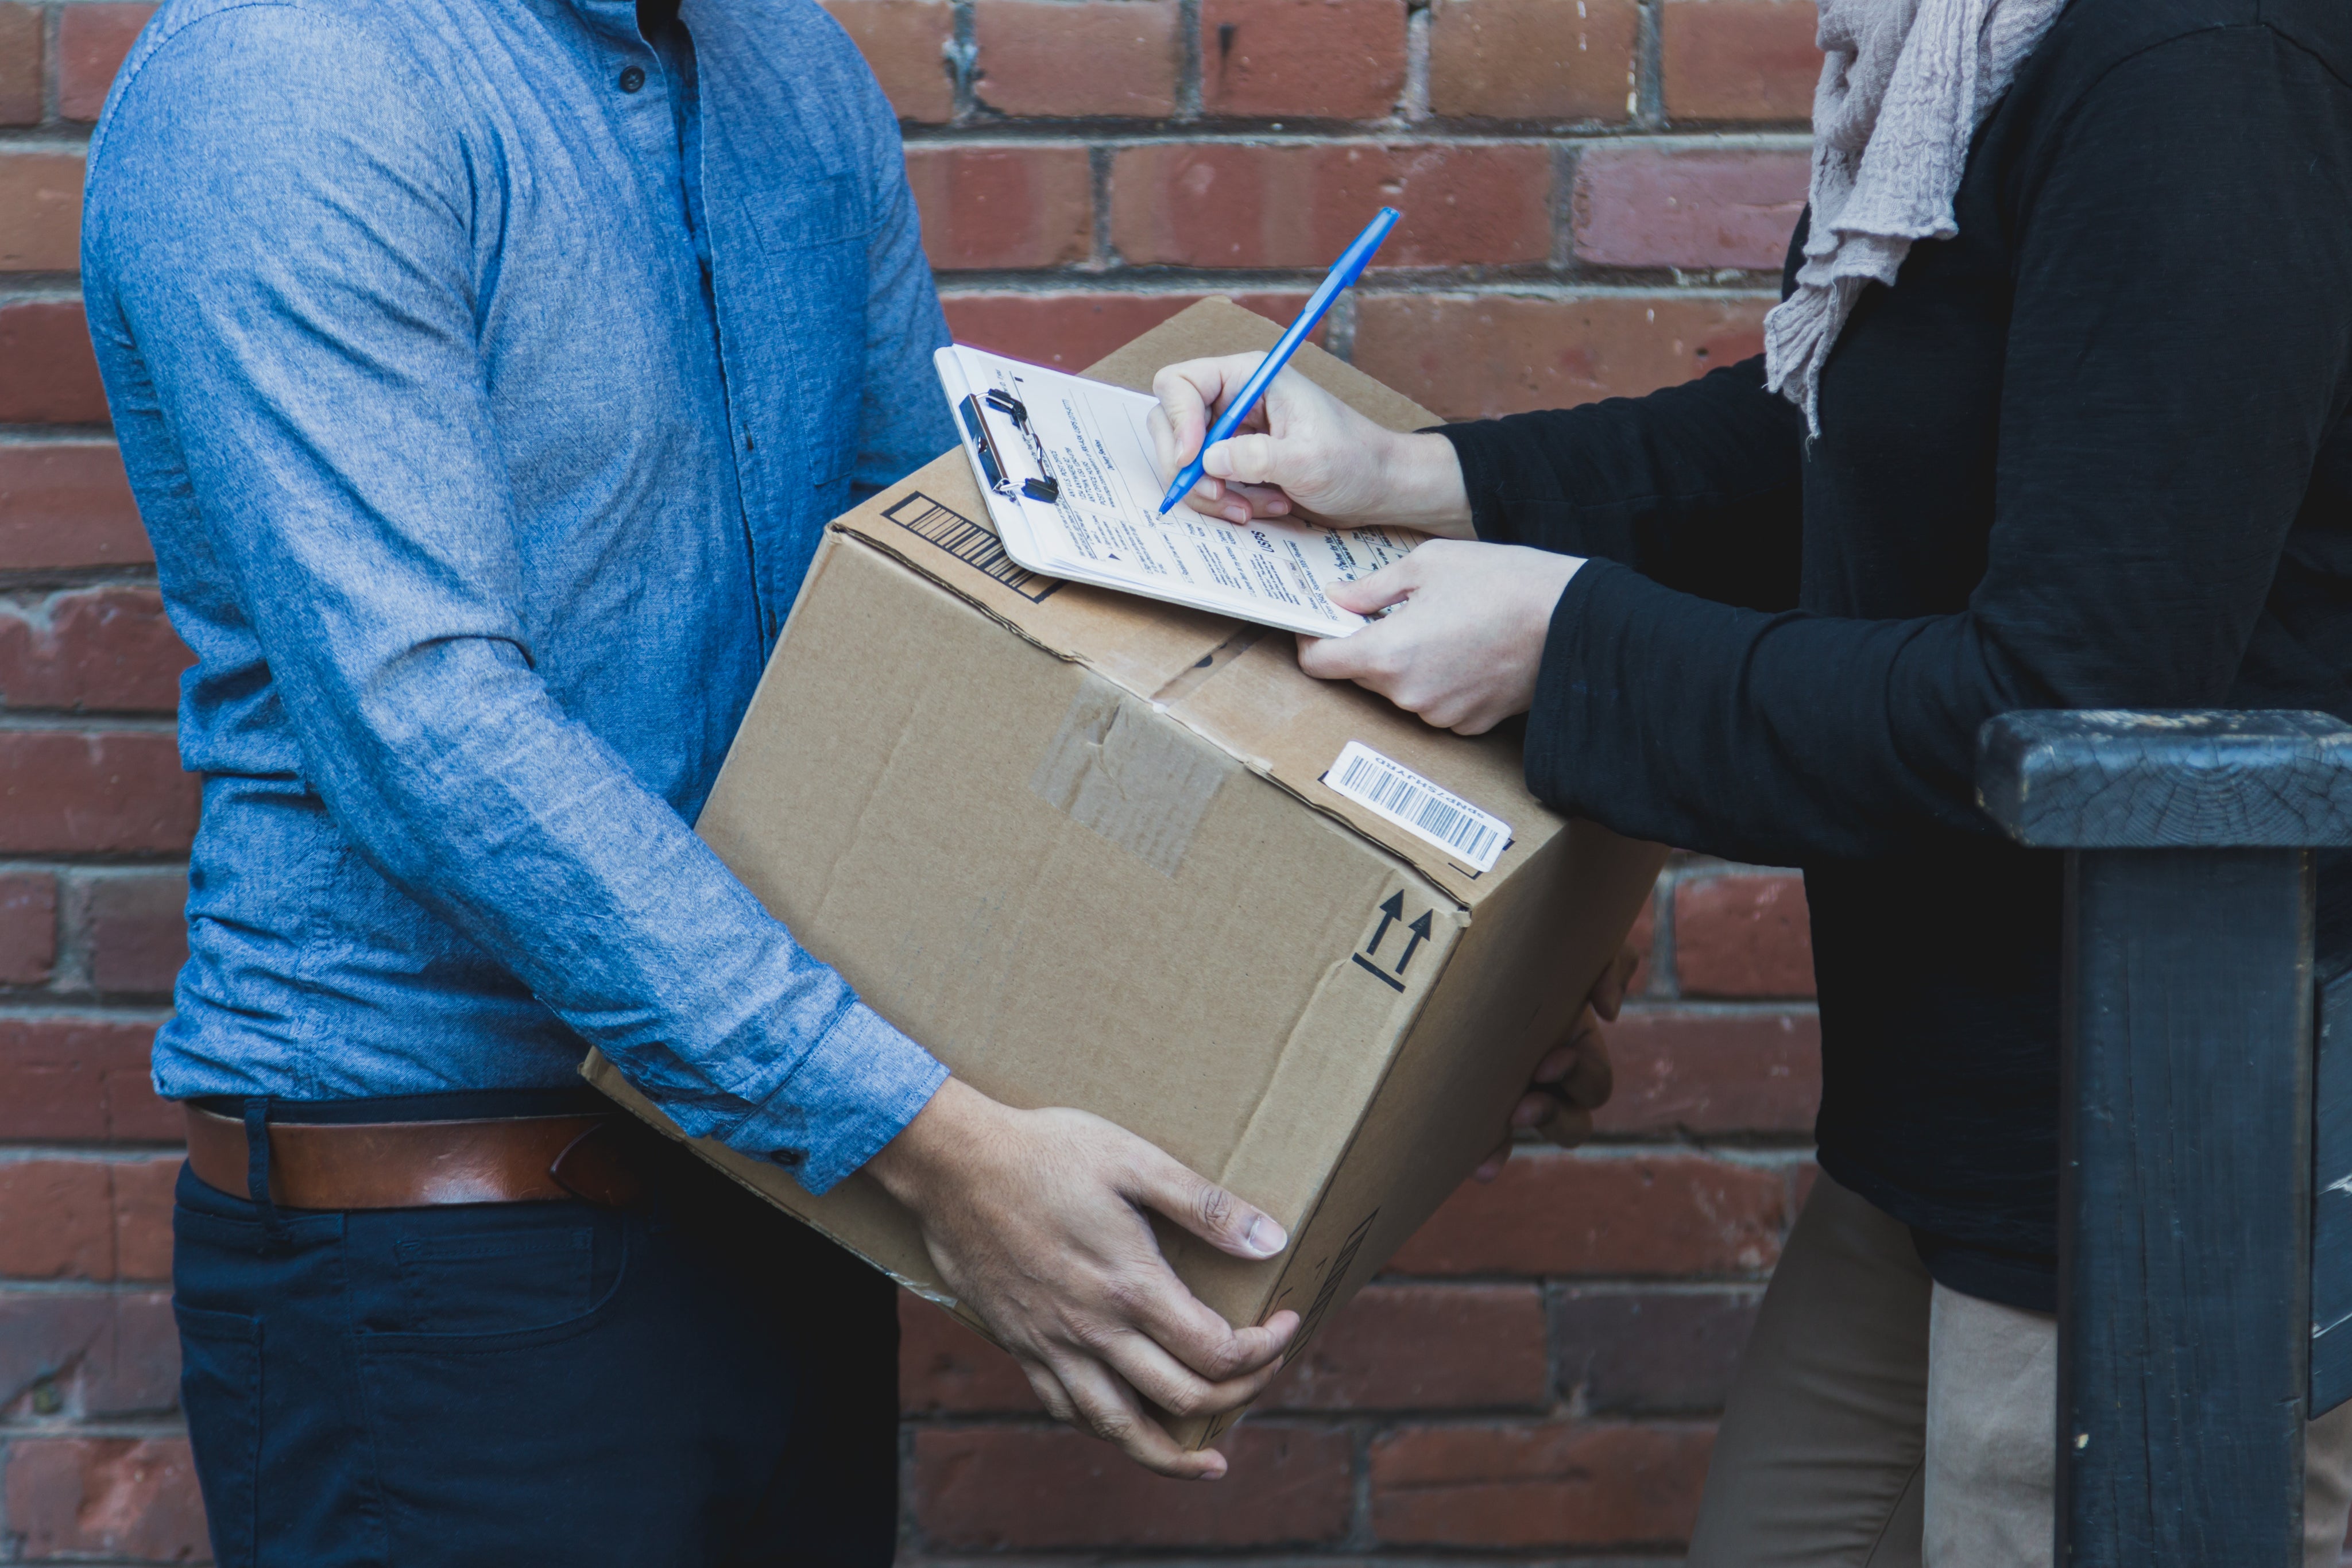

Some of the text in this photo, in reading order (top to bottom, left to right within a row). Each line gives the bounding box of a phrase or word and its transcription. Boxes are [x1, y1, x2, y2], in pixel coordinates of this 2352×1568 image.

[1095, 440, 1105, 455] Section
[1050, 450, 1062, 464] OFFICE
[1058, 464, 1066, 476] POST
[1089, 476, 1101, 492] OFFICE
[1096, 493, 1106, 505] POST
[1251, 531, 1274, 552] USPS
